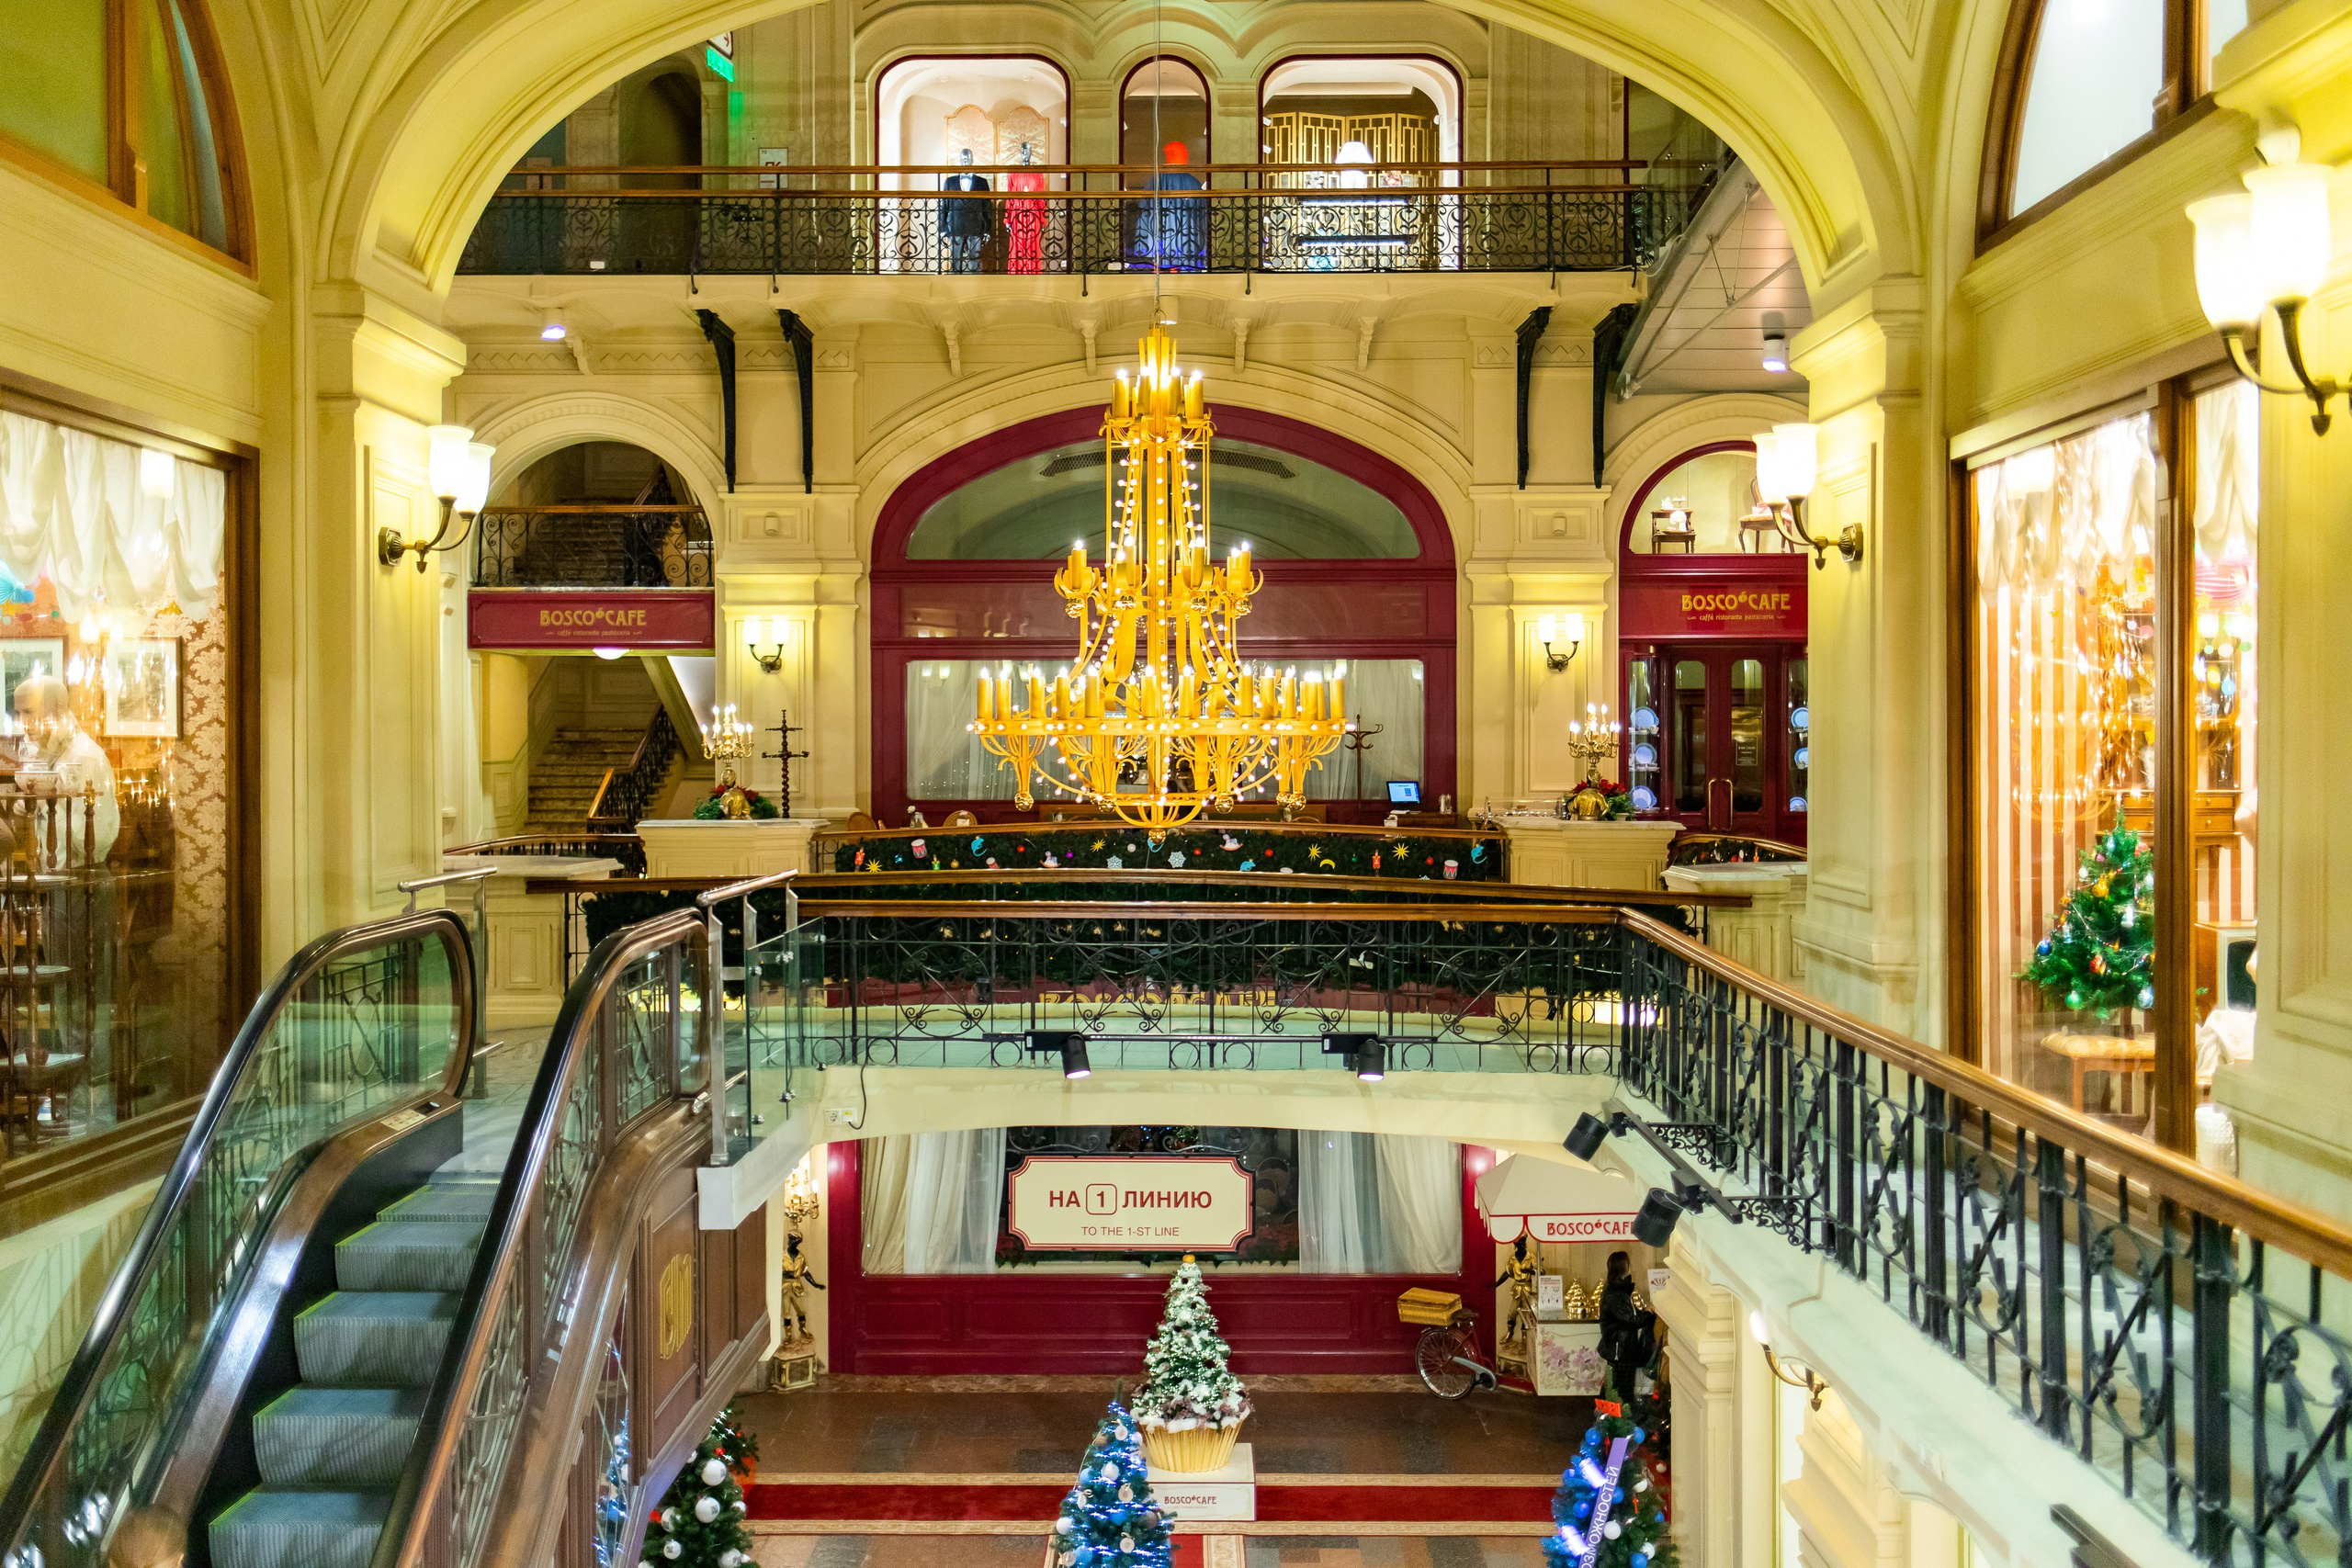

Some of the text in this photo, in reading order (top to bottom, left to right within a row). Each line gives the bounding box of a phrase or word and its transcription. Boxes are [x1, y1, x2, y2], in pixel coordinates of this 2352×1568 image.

[1681, 593, 1791, 611] BOSCO CAFE
[539, 610, 647, 626] BOSCO CAFE
[1049, 1190, 1212, 1209] НА 1 ЛИНИЮ
[1081, 1226, 1180, 1236] TO THE 1-ST LINE
[1546, 1222, 1594, 1235] BOSCO
[1164, 1495, 1216, 1505] BOSCO CAFE
